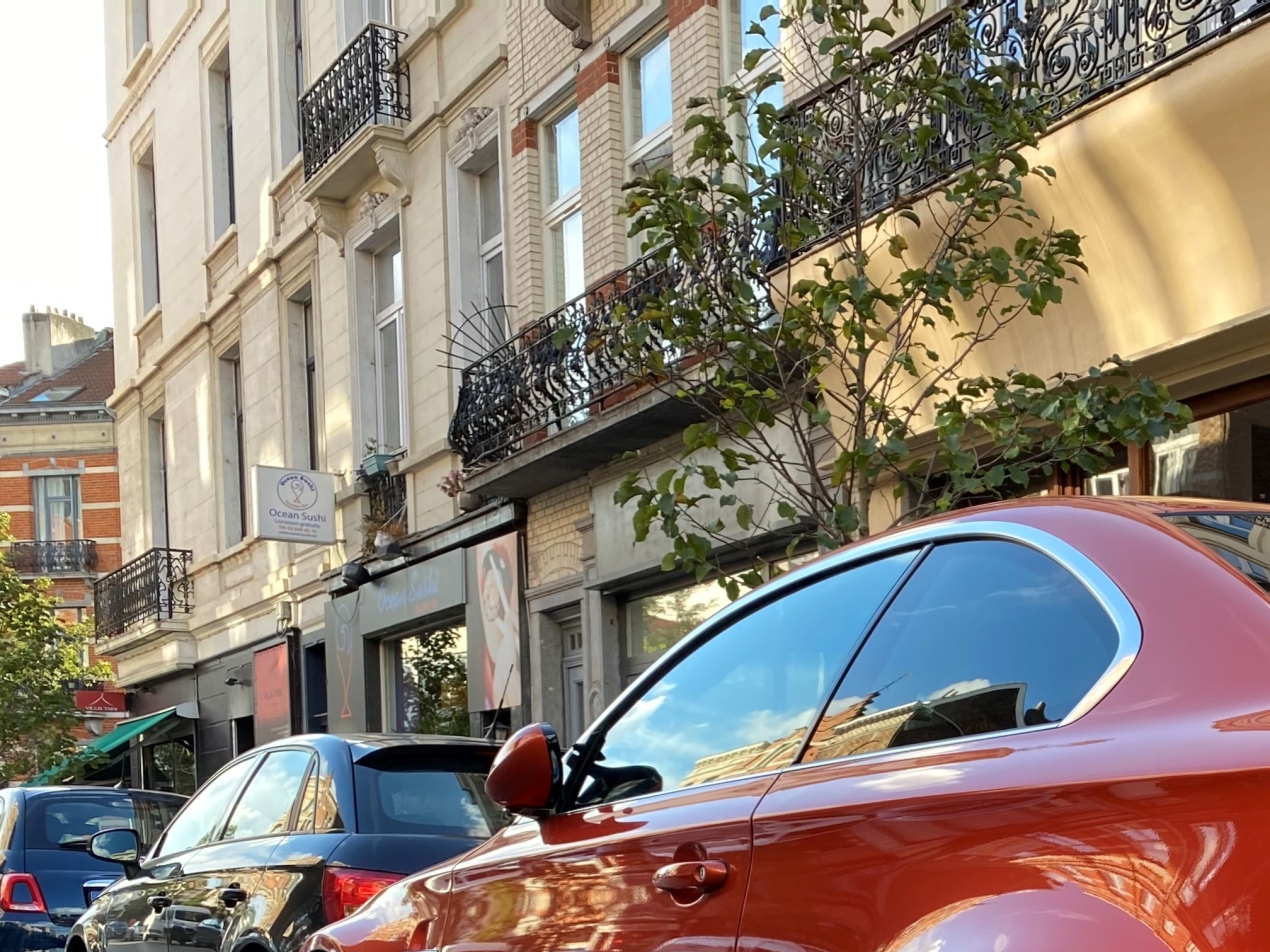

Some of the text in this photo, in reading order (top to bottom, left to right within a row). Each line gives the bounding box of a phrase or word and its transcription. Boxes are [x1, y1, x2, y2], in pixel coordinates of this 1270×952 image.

[269, 508, 326, 522] Ocean Sushi
[408, 564, 439, 602] Sushi
